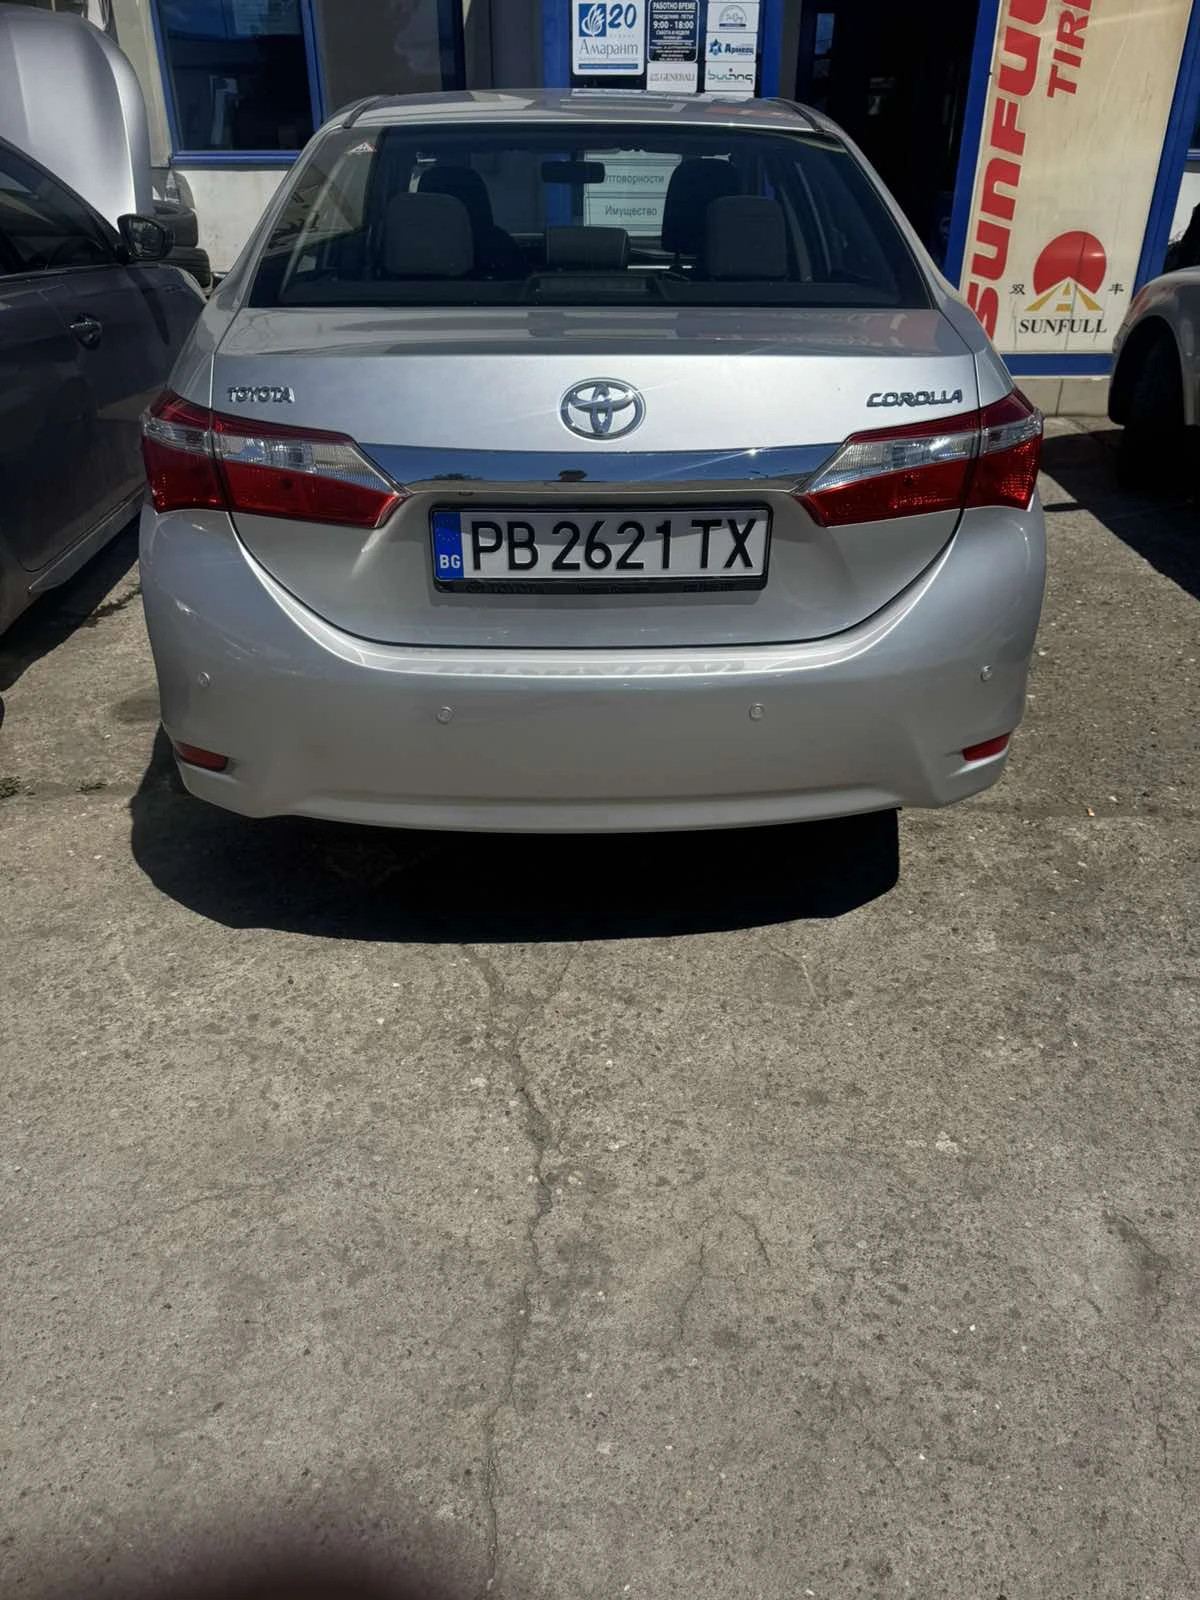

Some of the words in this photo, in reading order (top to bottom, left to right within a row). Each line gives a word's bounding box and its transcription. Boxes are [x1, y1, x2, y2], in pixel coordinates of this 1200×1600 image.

[608, 3, 637, 29] 20
[653, 21, 669, 29] 9:00
[675, 21, 695, 29] 18:00
[580, 38, 639, 58] Амарант
[605, 203, 657, 218] Имущество
[1010, 283, 1025, 296] 双
[1018, 318, 1107, 336] SUNFULL
[227, 386, 295, 404] TOYOTA
[866, 389, 962, 407] COROLLA
[471, 520, 538, 571] PB
[551, 519, 671, 571] 2621
[691, 518, 757, 569] TX
[439, 554, 461, 569] BG
